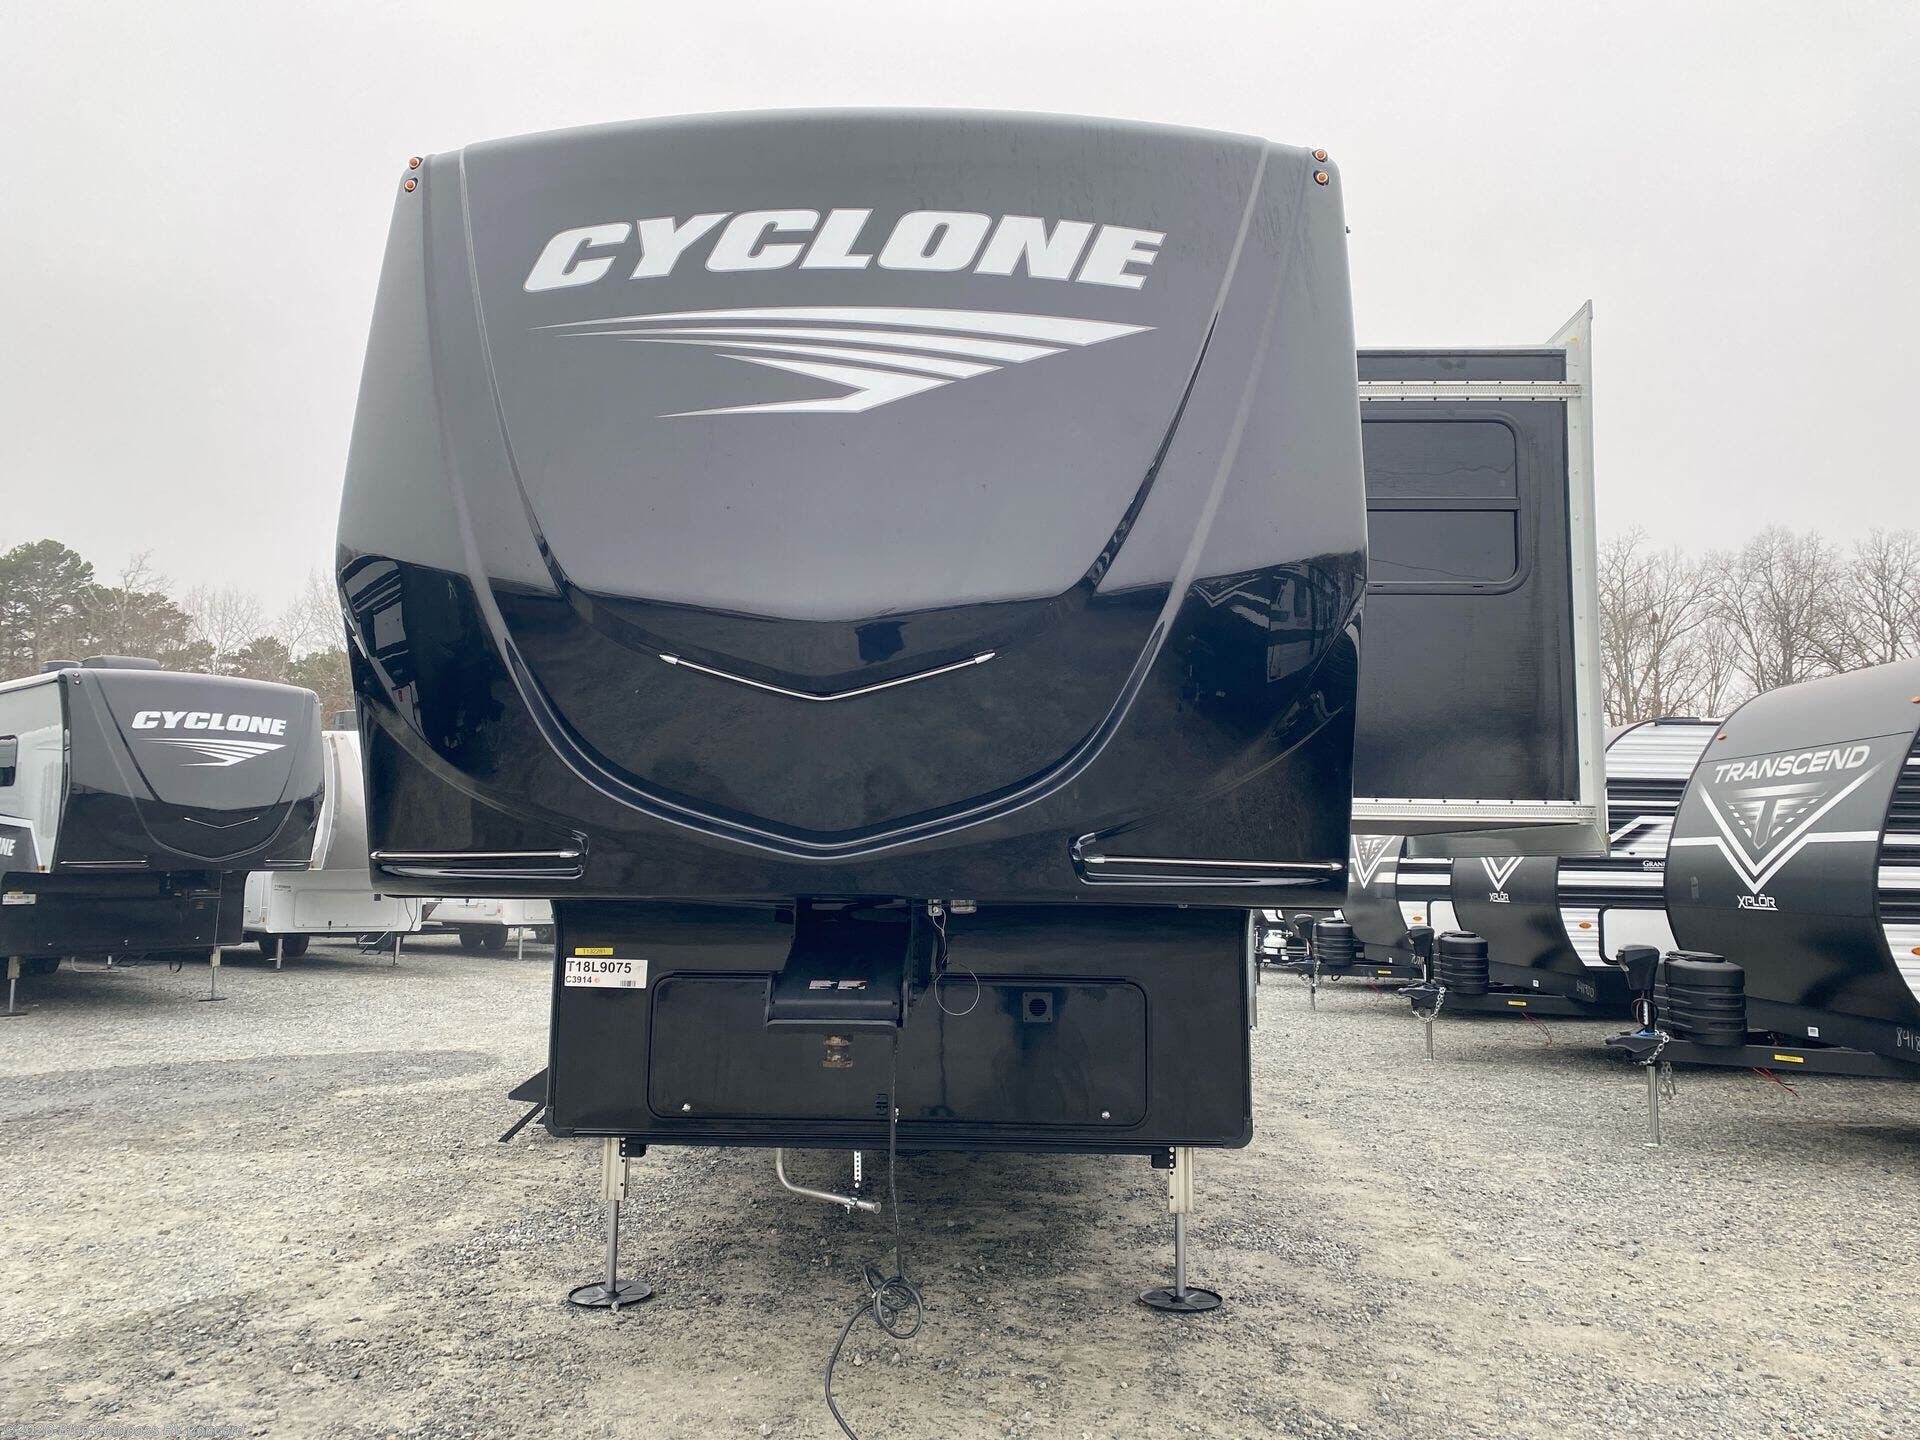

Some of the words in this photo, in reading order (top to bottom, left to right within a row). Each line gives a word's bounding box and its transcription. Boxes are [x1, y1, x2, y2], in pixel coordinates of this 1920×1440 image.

[523, 208, 1166, 292] CYCLONE
[131, 710, 287, 736] CYCLONE
[1714, 745, 1870, 784] TRANSCEND
[565, 976, 592, 984] C3914
[567, 961, 632, 974] T18L9075
